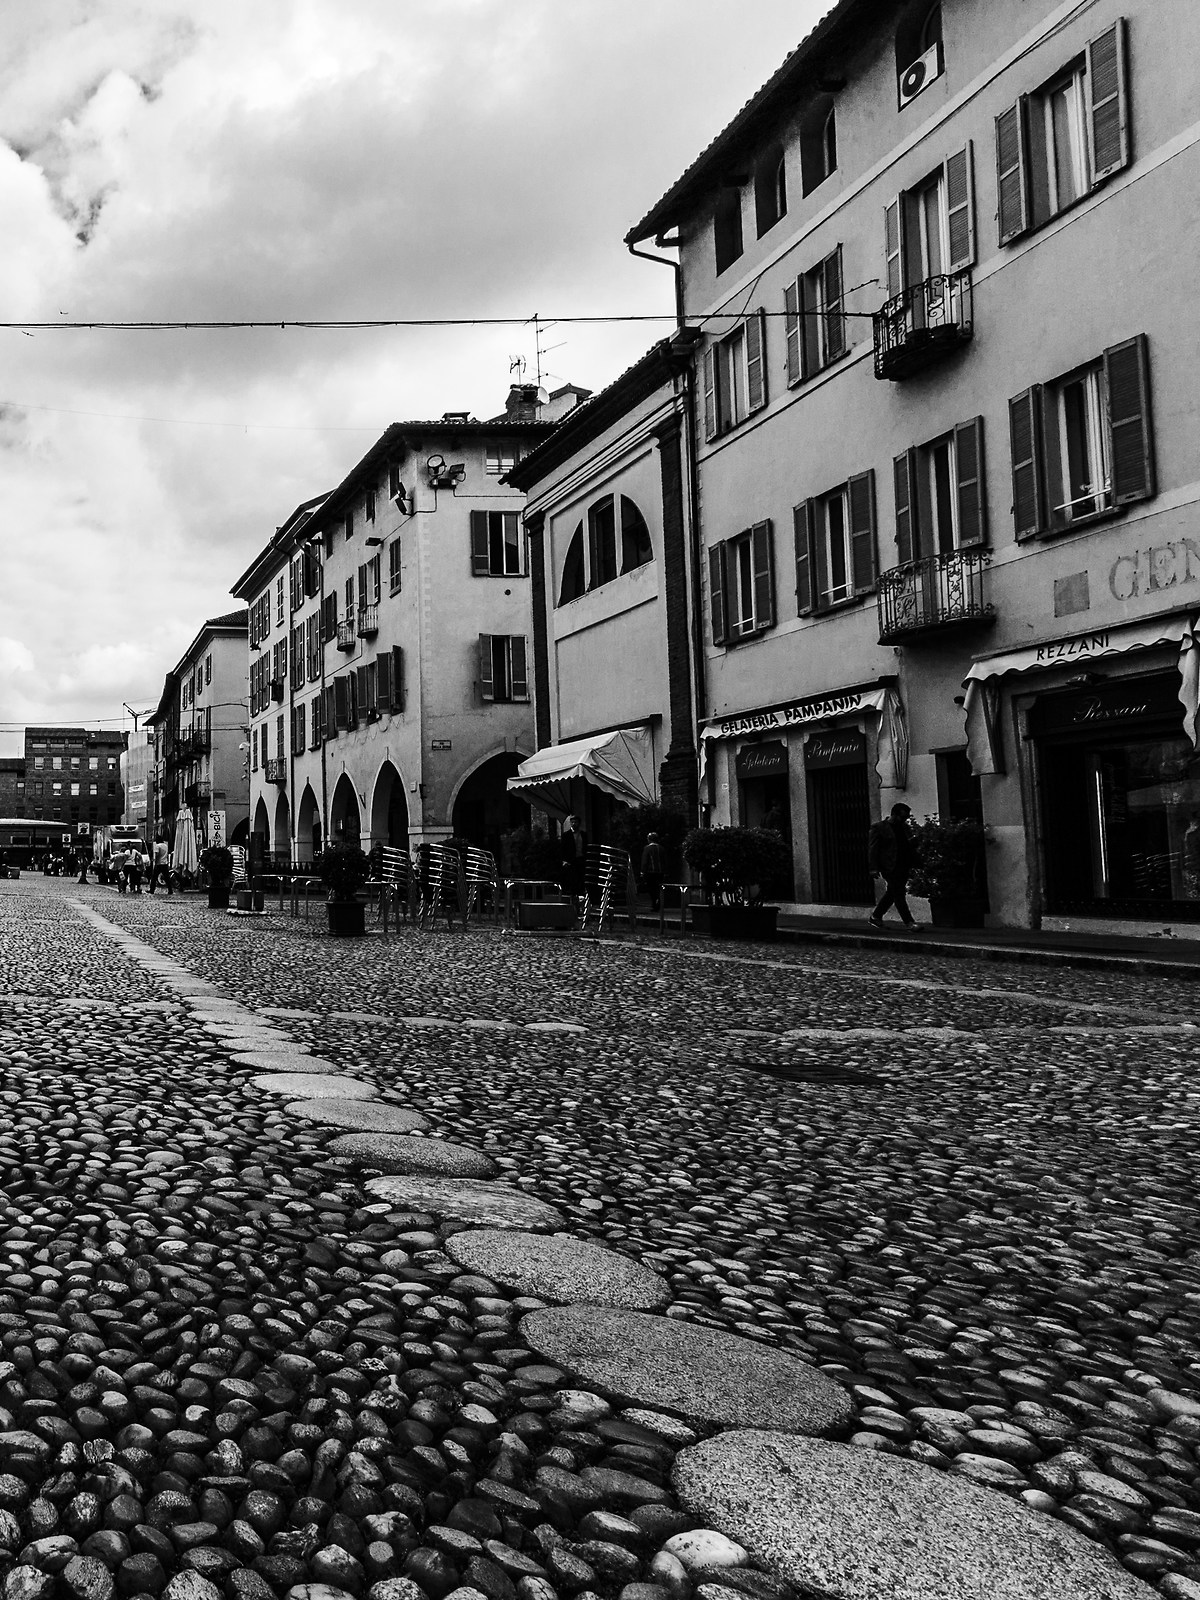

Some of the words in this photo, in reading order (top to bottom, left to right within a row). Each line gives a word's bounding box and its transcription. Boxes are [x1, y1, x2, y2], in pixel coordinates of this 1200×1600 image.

[1037, 634, 1109, 661] REZZANI
[721, 713, 779, 734] GELATERIA
[784, 694, 862, 722] PAMPANIN
[1073, 696, 1152, 722] Rezzani
[742, 751, 780, 770] Gelateria
[807, 739, 860, 762] Pampanin
